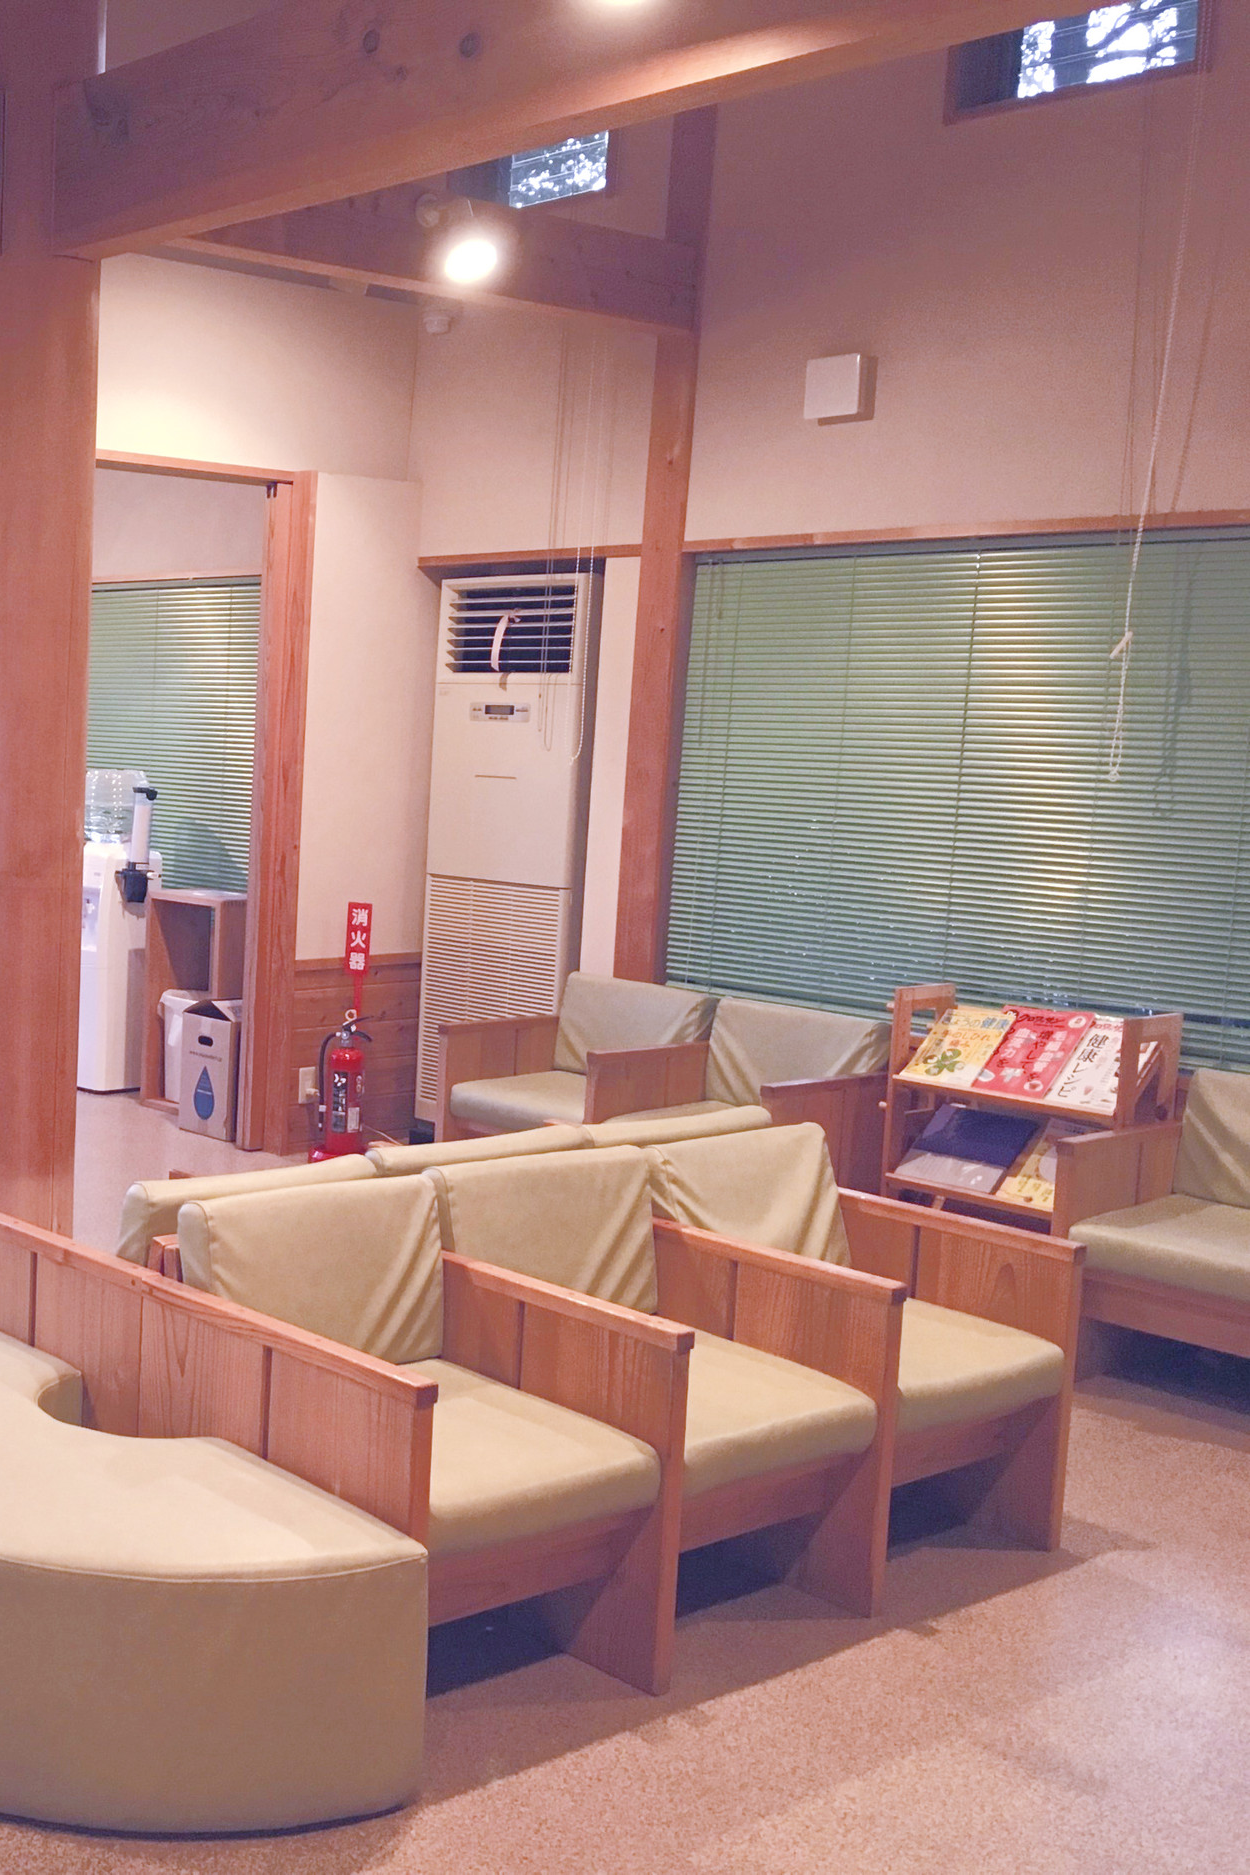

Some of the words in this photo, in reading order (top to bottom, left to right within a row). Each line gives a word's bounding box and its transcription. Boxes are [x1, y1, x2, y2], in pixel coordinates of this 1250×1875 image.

[349, 908, 368, 970] 消火器
[1058, 1033, 1109, 1097] 健康レシピ
